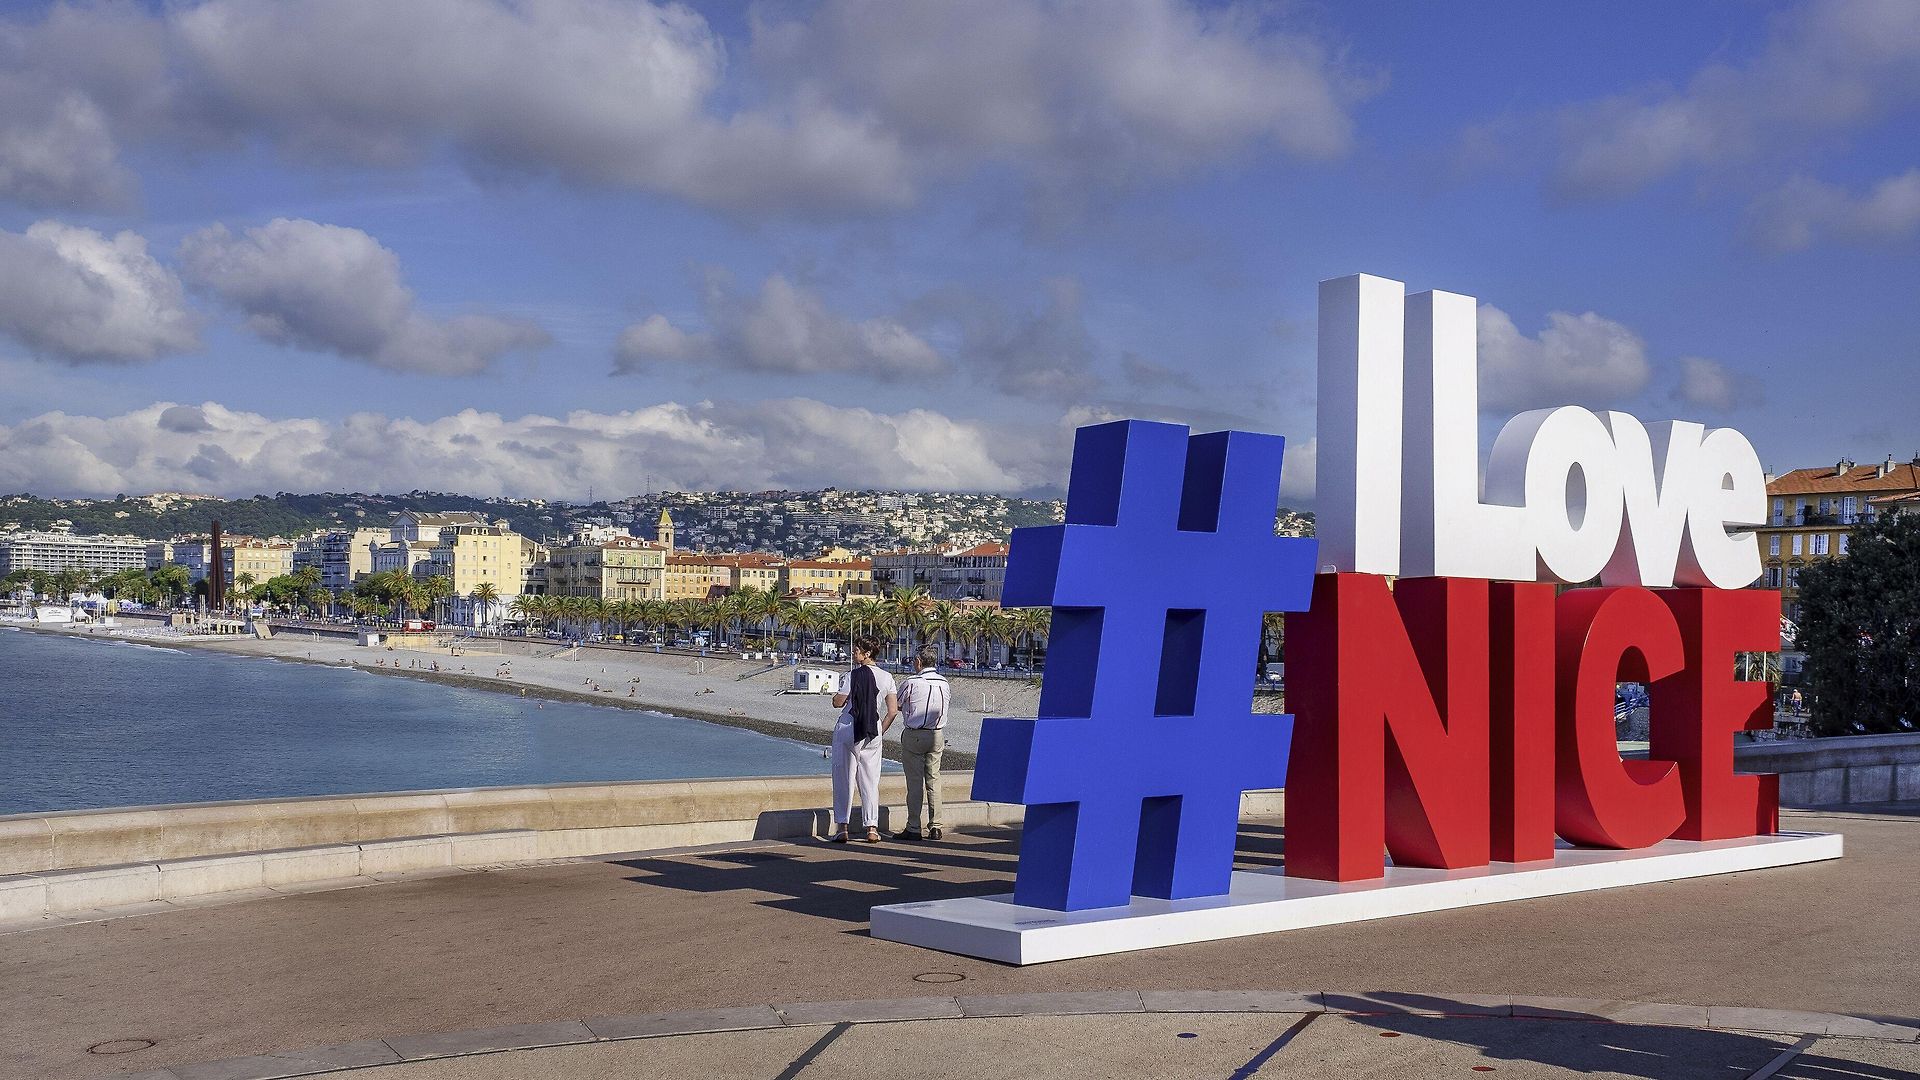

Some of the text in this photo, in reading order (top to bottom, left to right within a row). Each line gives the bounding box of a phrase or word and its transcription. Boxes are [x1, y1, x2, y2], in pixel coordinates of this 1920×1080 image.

[1316, 273, 1768, 590] I Love
[1285, 572, 1781, 882] NICE
